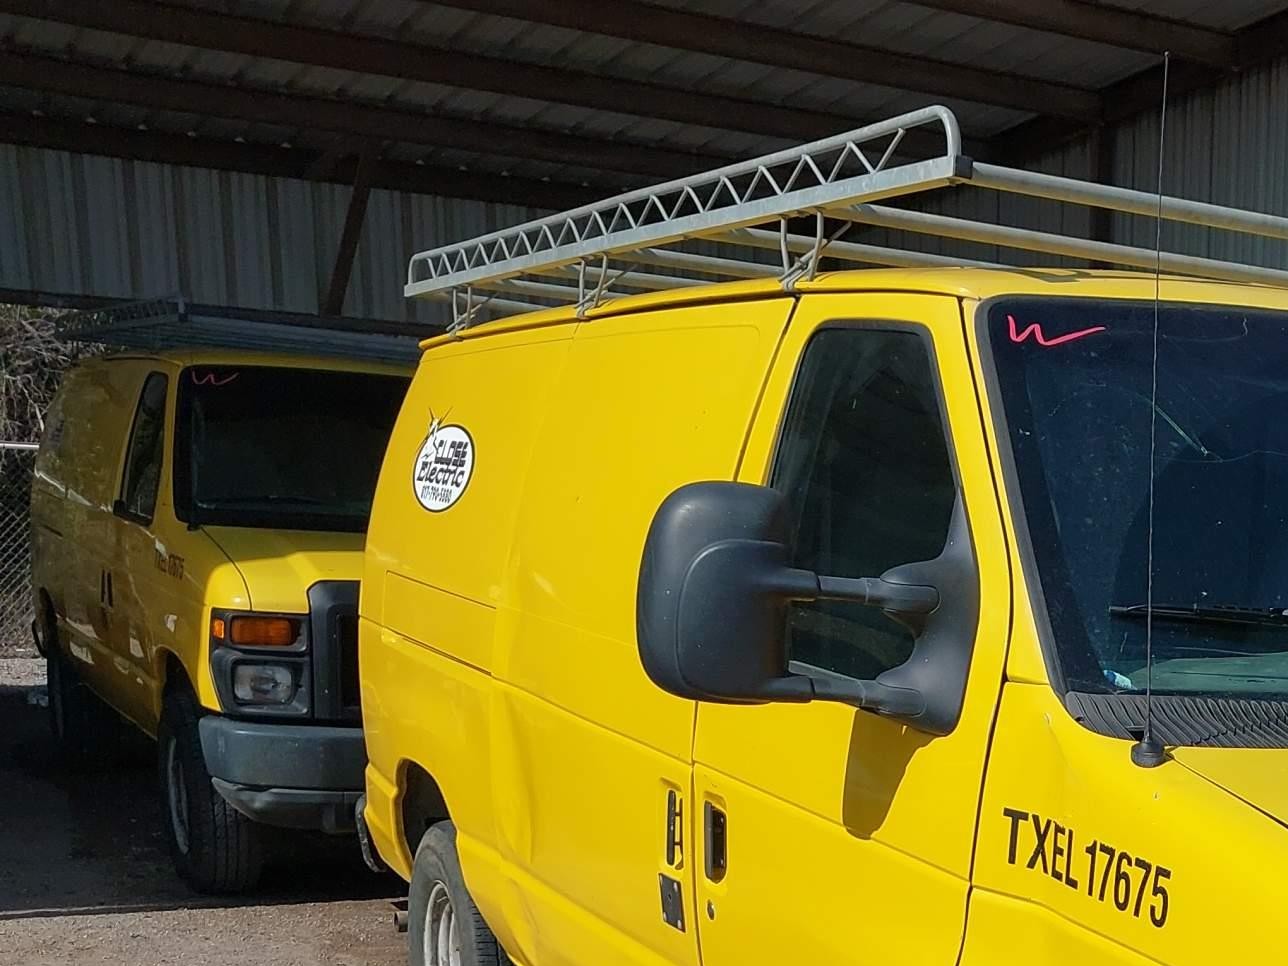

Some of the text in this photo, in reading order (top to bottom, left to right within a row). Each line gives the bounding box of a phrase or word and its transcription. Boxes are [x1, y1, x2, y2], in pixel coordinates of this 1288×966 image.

[416, 460, 465, 488] Electric
[1003, 807, 1171, 928] TXEL 17675
